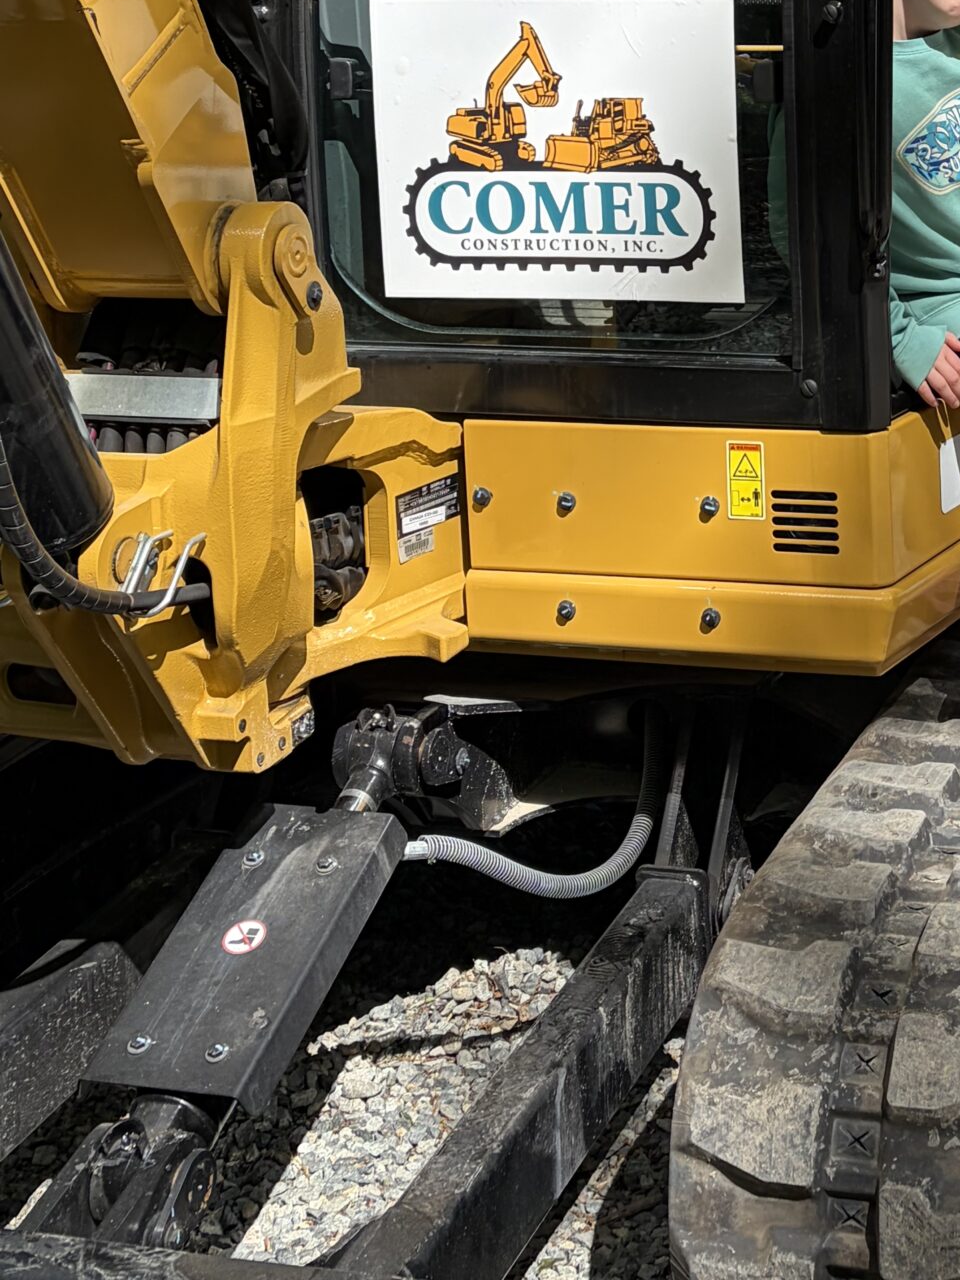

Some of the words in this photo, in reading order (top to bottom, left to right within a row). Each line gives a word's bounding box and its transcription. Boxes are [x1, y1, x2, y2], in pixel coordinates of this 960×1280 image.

[428, 180, 689, 237] COMER
[461, 238, 616, 254] CONSTRUCTION,
[624, 240, 664, 253] INC.
